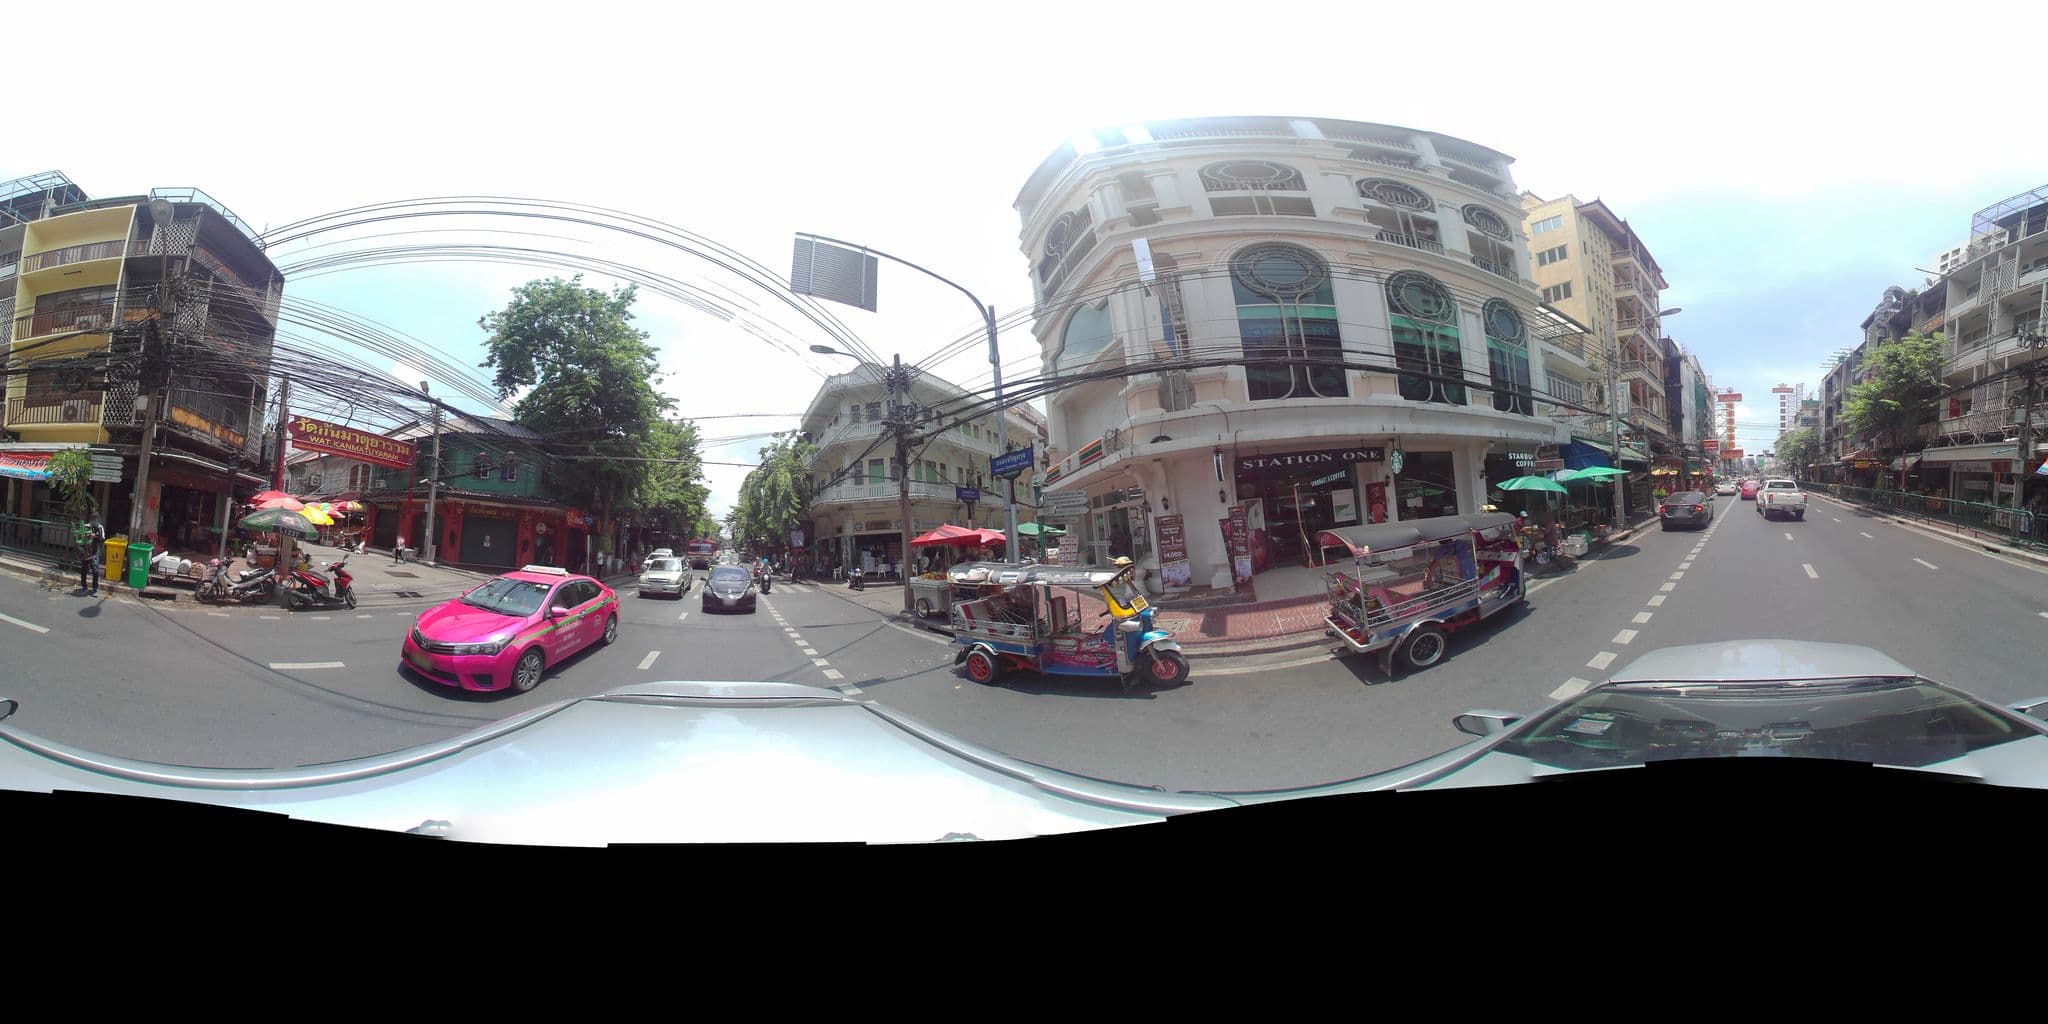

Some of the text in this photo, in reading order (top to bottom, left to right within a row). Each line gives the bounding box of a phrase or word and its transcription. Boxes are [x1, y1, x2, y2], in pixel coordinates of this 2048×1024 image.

[296, 417, 410, 456] วัดกันมาตุยาราม
[309, 435, 399, 460] WAT KANMATUYARAM
[1242, 450, 1380, 470] STATION ONE
[1508, 452, 1534, 460] STARBU
